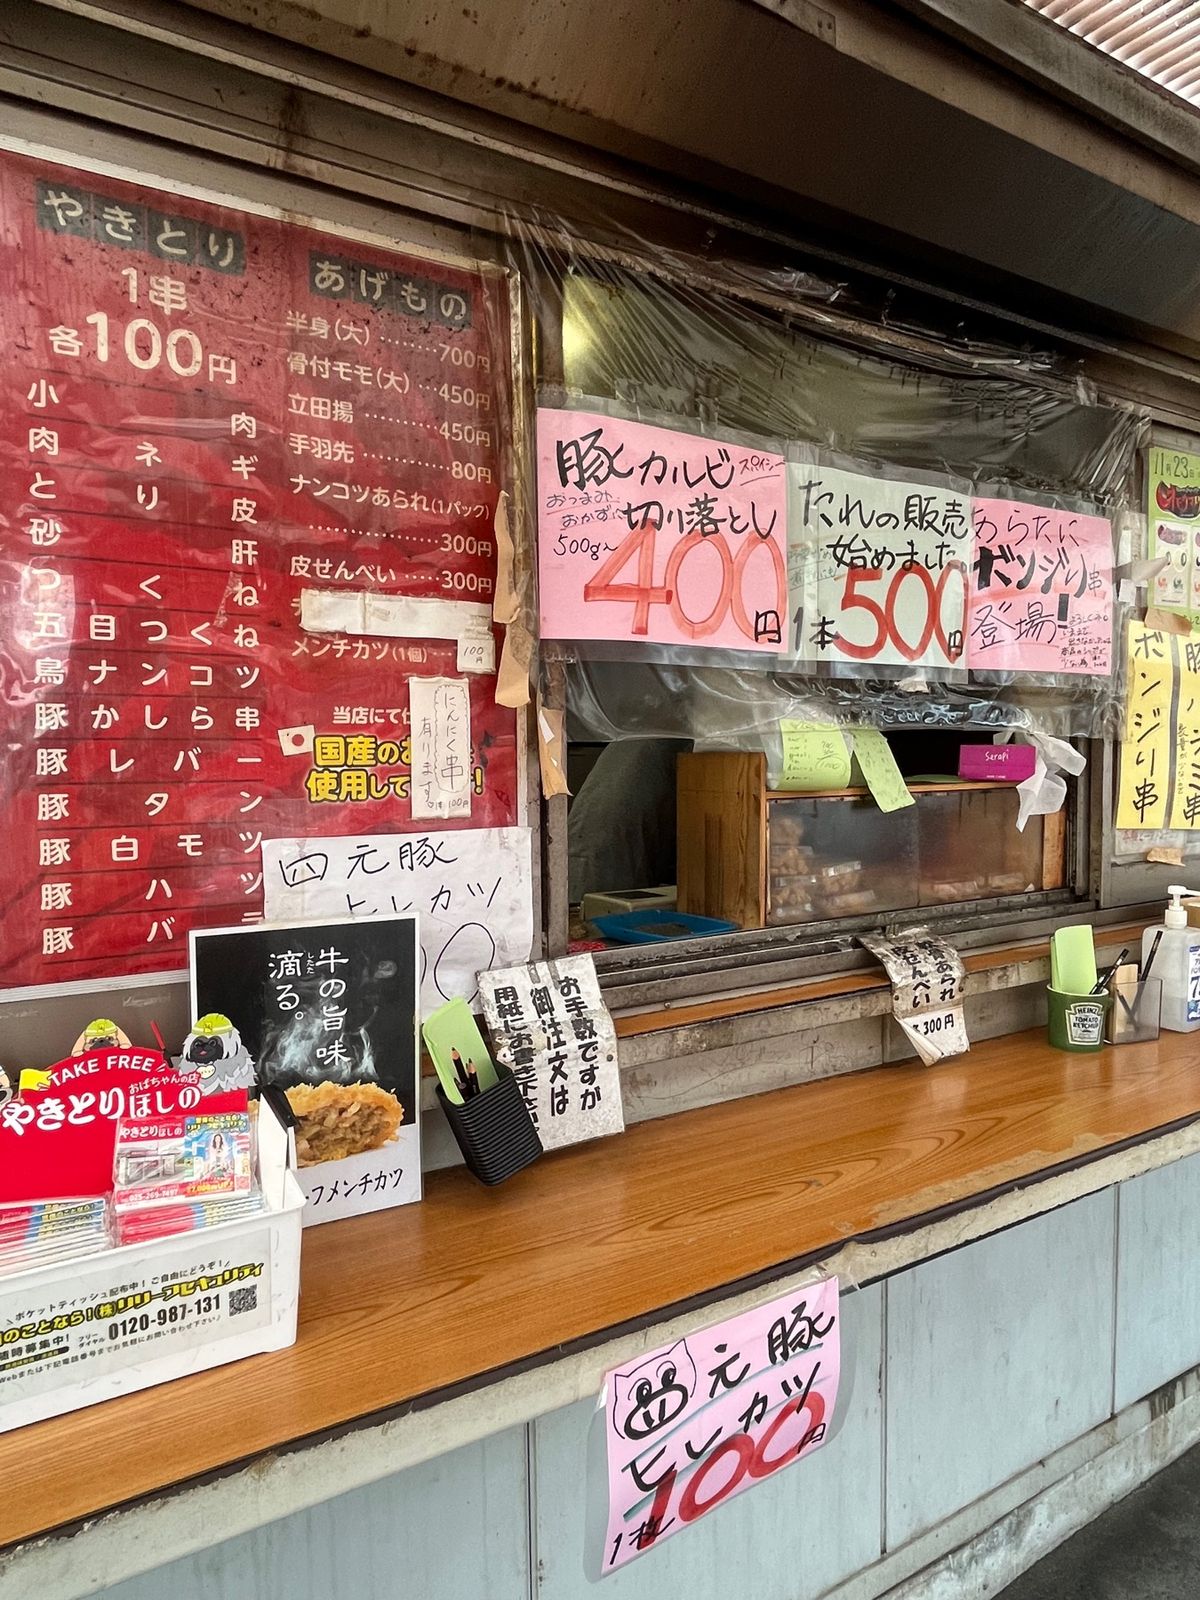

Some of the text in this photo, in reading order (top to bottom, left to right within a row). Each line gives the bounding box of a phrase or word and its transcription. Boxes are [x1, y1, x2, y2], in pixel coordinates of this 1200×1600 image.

[44, 189, 235, 267] やきとり
[121, 267, 188, 316] 1串
[314, 260, 467, 320] あげもの
[439, 344, 491, 374] 700円
[288, 393, 491, 448] 立田揚 450円
[439, 383, 491, 411] 450円
[289, 433, 492, 484] 手羽先 80円
[622, 493, 777, 540] 切り落とし
[799, 480, 969, 539] たれの販売
[440, 534, 492, 557] 300円
[826, 534, 956, 571] 始めました
[289, 555, 493, 593] 皮せんべい 300円
[440, 692, 464, 790] にんにく串
[1132, 631, 1164, 823] ボンジリ串
[279, 837, 458, 887] 四元豚
[315, 946, 350, 1066] 牛の旨味
[1074, 1016, 1099, 1024] TOMATO
[1077, 1006, 1098, 1015] HEINZ
[529, 986, 569, 1117] 御注文は
[558, 975, 601, 1111] お手数ですが
[47, 1055, 156, 1088] TAKE FREE
[128, 1073, 200, 1095] おばちゃんの店
[305, 1168, 404, 1206] フメンチカツ
[108, 1293, 222, 1341] 0120-987-131
